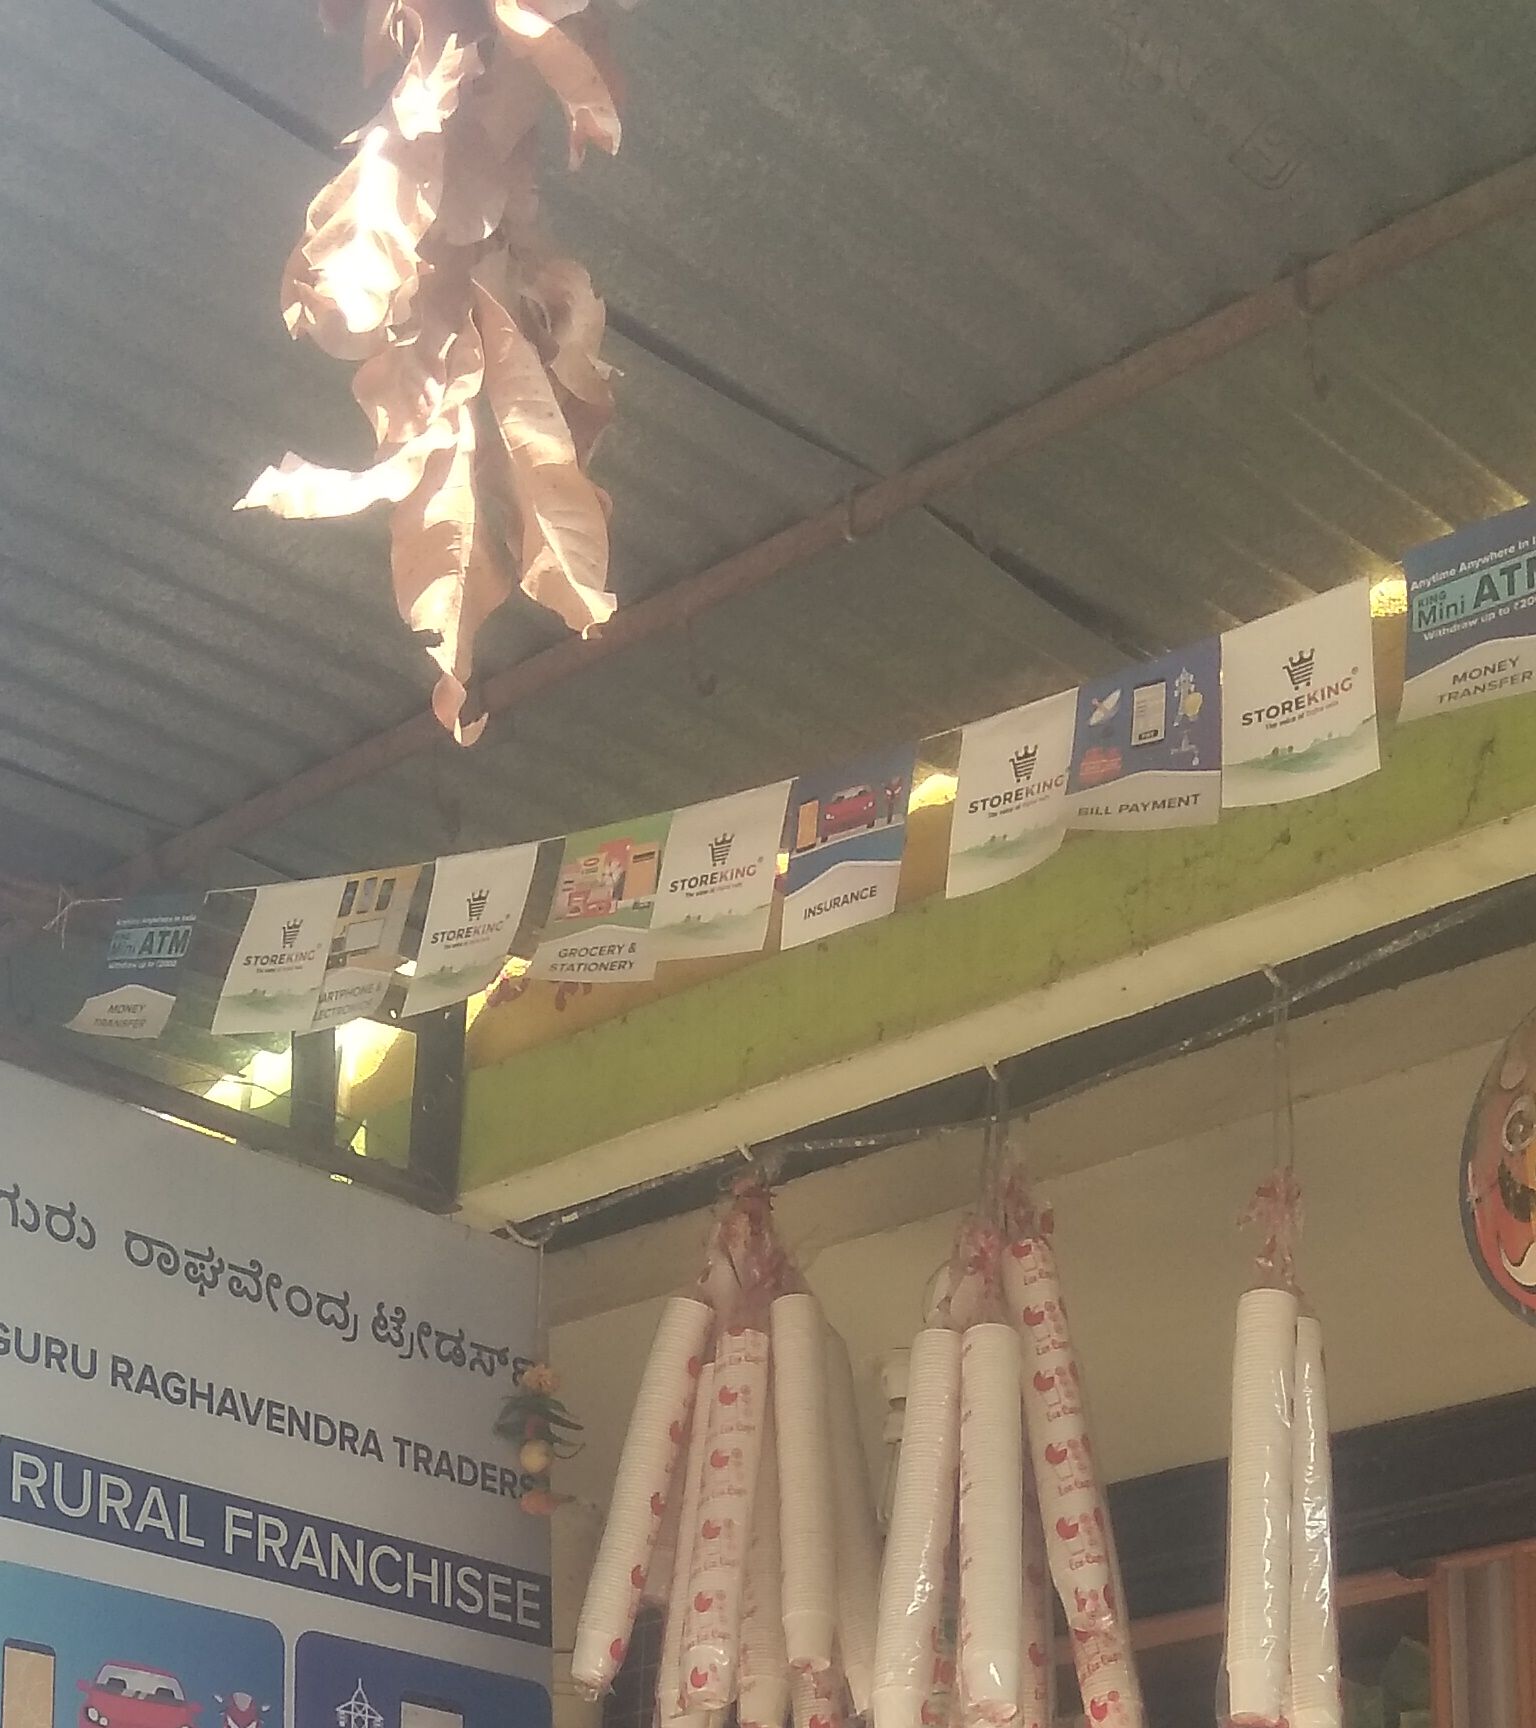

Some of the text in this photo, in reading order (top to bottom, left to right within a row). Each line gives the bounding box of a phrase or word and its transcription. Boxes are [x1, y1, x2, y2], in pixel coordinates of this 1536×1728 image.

[1410, 568, 1456, 591] Anytime
[1459, 545, 1515, 572] Anywhere
[1418, 590, 1447, 608] KING
[1418, 595, 1465, 628] Mini
[1423, 617, 1478, 641] Withdraw
[1480, 611, 1496, 623] up
[1498, 606, 1510, 617] to
[1451, 655, 1521, 686] MONEY
[1241, 677, 1353, 727] STOREKING
[1437, 669, 1534, 704] TRANSFER
[969, 774, 1064, 814] STOREKING
[1078, 793, 1201, 817] BILL PAYMENT
[669, 863, 757, 894] STOREKING
[804, 885, 878, 920] INSURANCE
[138, 928, 191, 956] ATM
[431, 921, 504, 944] STOREKING
[243, 950, 316, 967] STOREKING
[558, 942, 637, 959] GROCERY &
[549, 959, 635, 974] STATIONERY
[107, 1003, 147, 1014] MONEY
[110, 1355, 384, 1463] RAGHAVENDRA
[10, 1450, 543, 1631] RURAL FRANCHISEE
